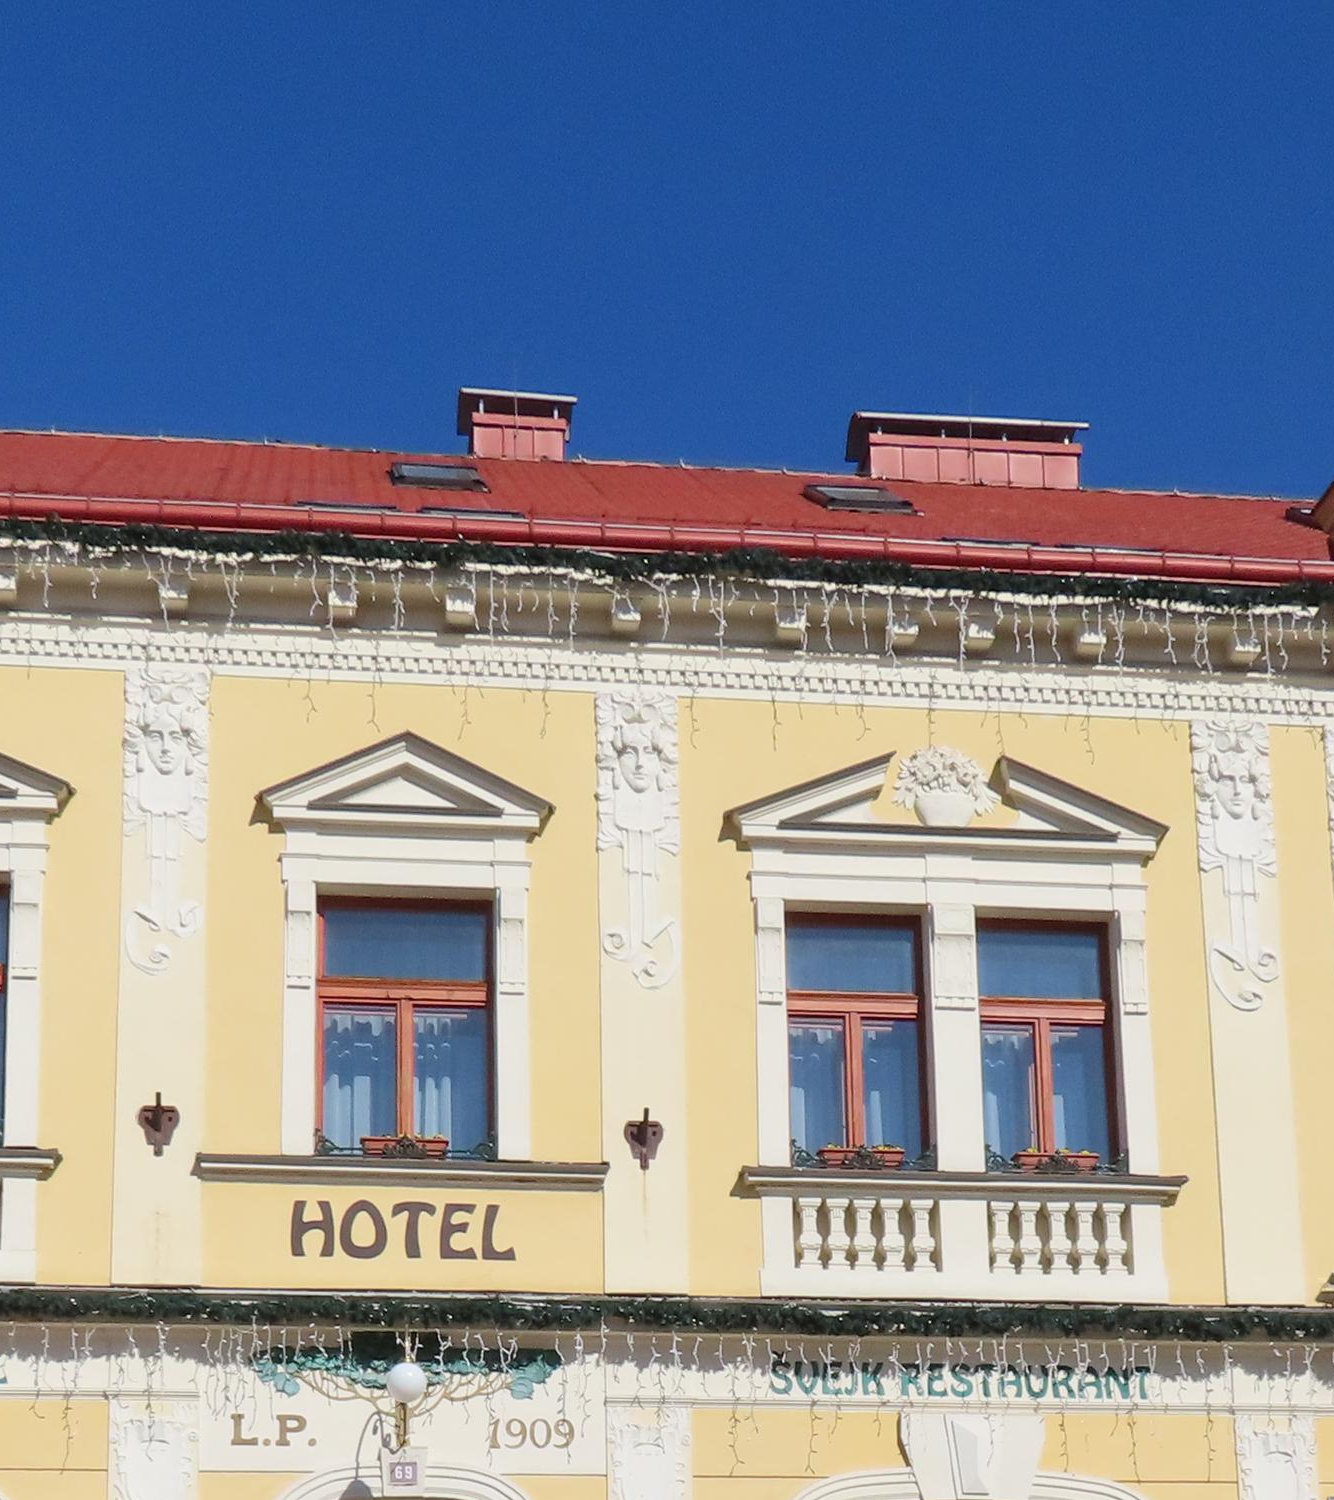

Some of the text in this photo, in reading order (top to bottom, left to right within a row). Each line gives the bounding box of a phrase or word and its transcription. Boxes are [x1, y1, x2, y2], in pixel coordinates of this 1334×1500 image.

[289, 1199, 517, 1262] HOTEL
[769, 1350, 1154, 1401] ŠVEJK RESTAURANT
[230, 1412, 318, 1448] L.P.
[489, 1417, 576, 1451] 1909
[394, 1465, 413, 1480] 69
